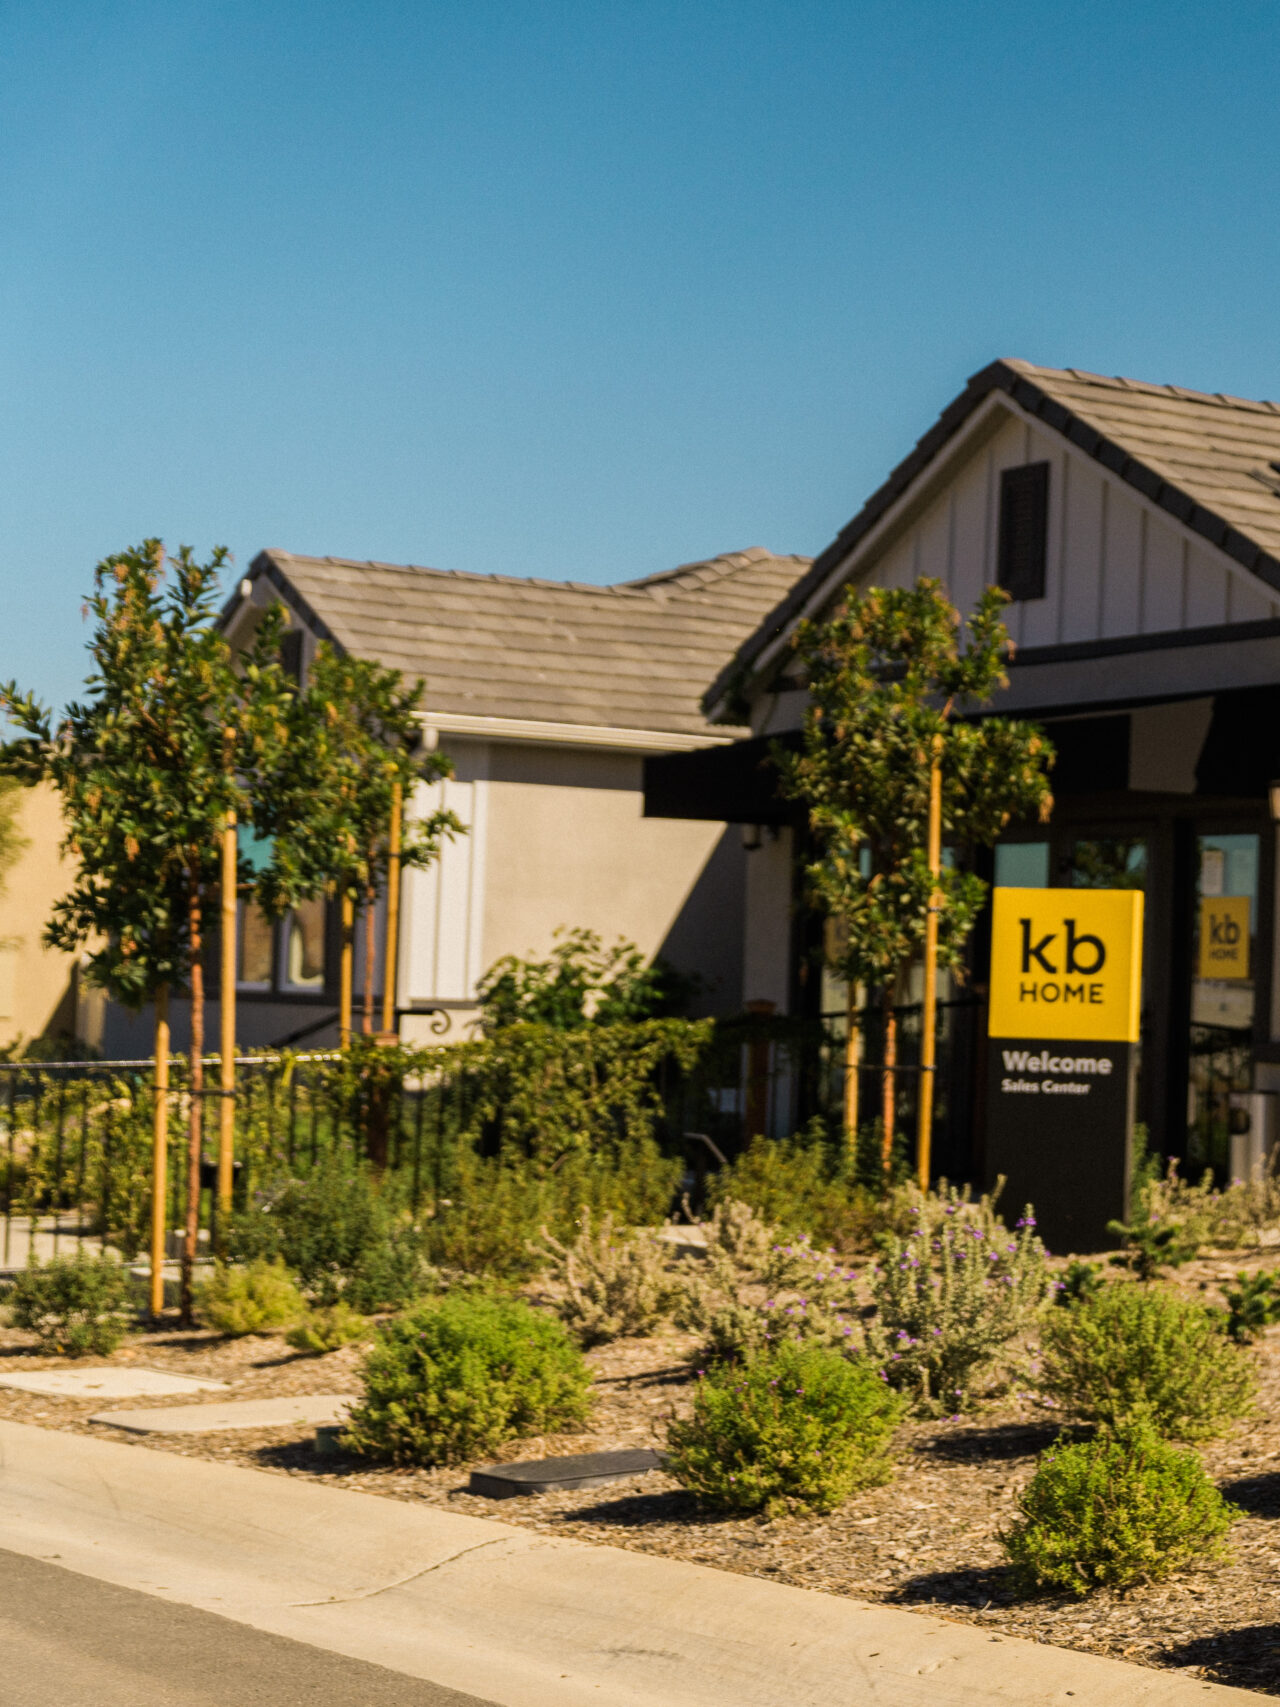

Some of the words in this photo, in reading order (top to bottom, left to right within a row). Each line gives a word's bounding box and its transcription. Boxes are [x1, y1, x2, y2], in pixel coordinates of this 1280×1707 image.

[1209, 914, 1241, 945] kb
[1018, 918, 1106, 975] kb
[1210, 949, 1239, 960] HOME
[1020, 982, 1104, 1004] HOME
[1002, 1050, 1113, 1075] Welcome
[1001, 1079, 1040, 1094] Sales
[1041, 1080, 1091, 1095] Center
